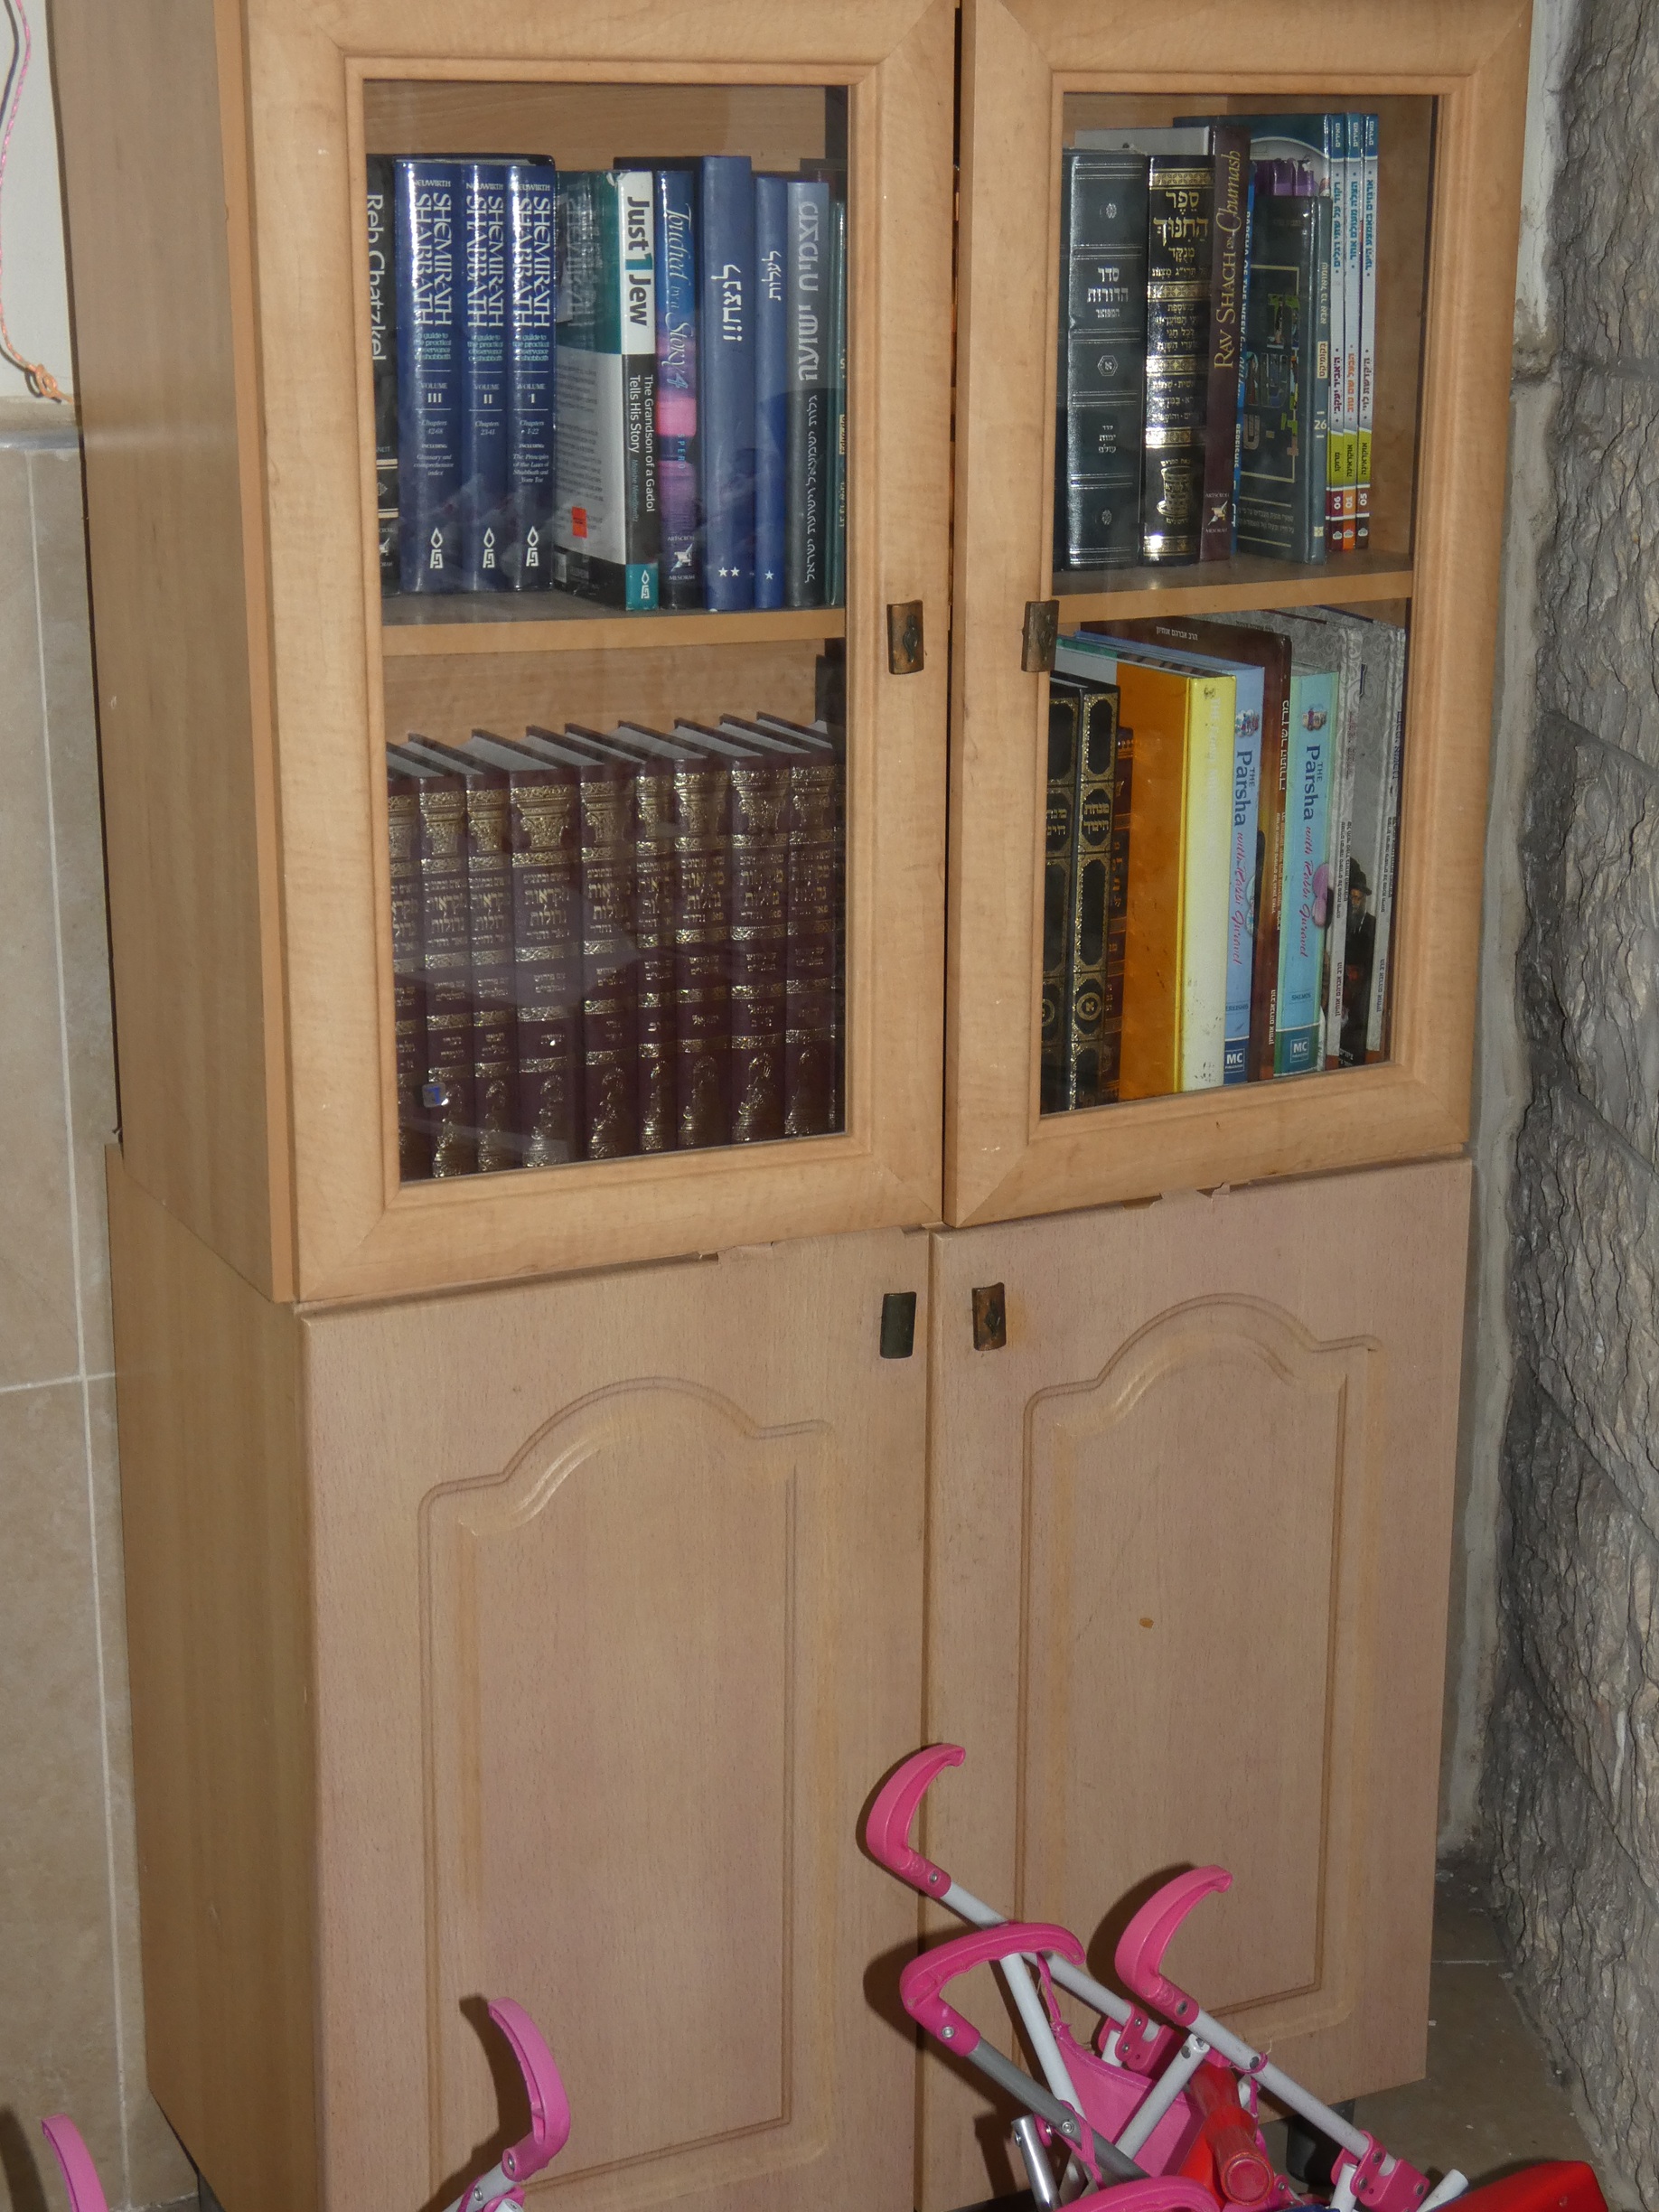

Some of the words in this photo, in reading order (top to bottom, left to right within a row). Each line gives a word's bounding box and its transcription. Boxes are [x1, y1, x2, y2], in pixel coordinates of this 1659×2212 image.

[1166, 192, 1200, 213] ספר
[1216, 150, 1242, 232] Chumash
[1350, 181, 1359, 207] הצלה
[367, 195, 383, 244] Reb
[627, 196, 650, 251] Just
[1334, 206, 1341, 217] על
[1349, 210, 1358, 238] מעולם
[666, 203, 691, 285] Touched
[1365, 212, 1373, 246] באמצע
[413, 193, 433, 324] SHABBATH
[433, 192, 451, 325] SHEMIRATH
[466, 195, 487, 327] SHABBATH
[489, 196, 503, 327] SHEMIRATH
[798, 201, 819, 292] מצמיח
[513, 197, 532, 327] SHABBATH
[534, 197, 550, 327] SHEMIRATH
[761, 250, 782, 301] לעלות
[1098, 267, 1120, 282] סדר
[1319, 262, 1329, 290] שמואל
[369, 248, 386, 360] Chatzkel
[629, 274, 651, 327] Jew
[711, 265, 743, 342] לנצח!!
[1087, 287, 1129, 303] הדורות
[1320, 293, 1327, 303] בר
[1319, 305, 1327, 324] אבא
[798, 305, 819, 381] ישועה
[1346, 353, 1355, 377] הבעל
[630, 375, 641, 400] Tells
[644, 375, 653, 396] The
[666, 373, 689, 389] 4
[1348, 380, 1354, 394] שם
[427, 393, 442, 403] III
[483, 394, 492, 404] II
[630, 403, 641, 420] His
[806, 394, 818, 426] גלות
[629, 423, 641, 453] Story
[644, 398, 654, 453] Grandson
[1314, 419, 1327, 430] 26
[645, 455, 654, 467] of
[678, 433, 686, 469] SPERO
[645, 479, 655, 511] Gadol
[1334, 496, 1341, 510] 06
[1359, 492, 1367, 506] 05
[807, 488, 816, 534] וישועת
[804, 539, 816, 583] ישראל
[1171, 629, 1187, 639] אברהם
[1234, 750, 1253, 827] Parsha
[1303, 745, 1321, 821] Parsha
[1236, 832, 1246, 862] with
[1304, 826, 1313, 855] with
[1302, 860, 1314, 899] Rabbi
[1226, 1053, 1242, 1064] MC
[1293, 1042, 1308, 1053] MC
